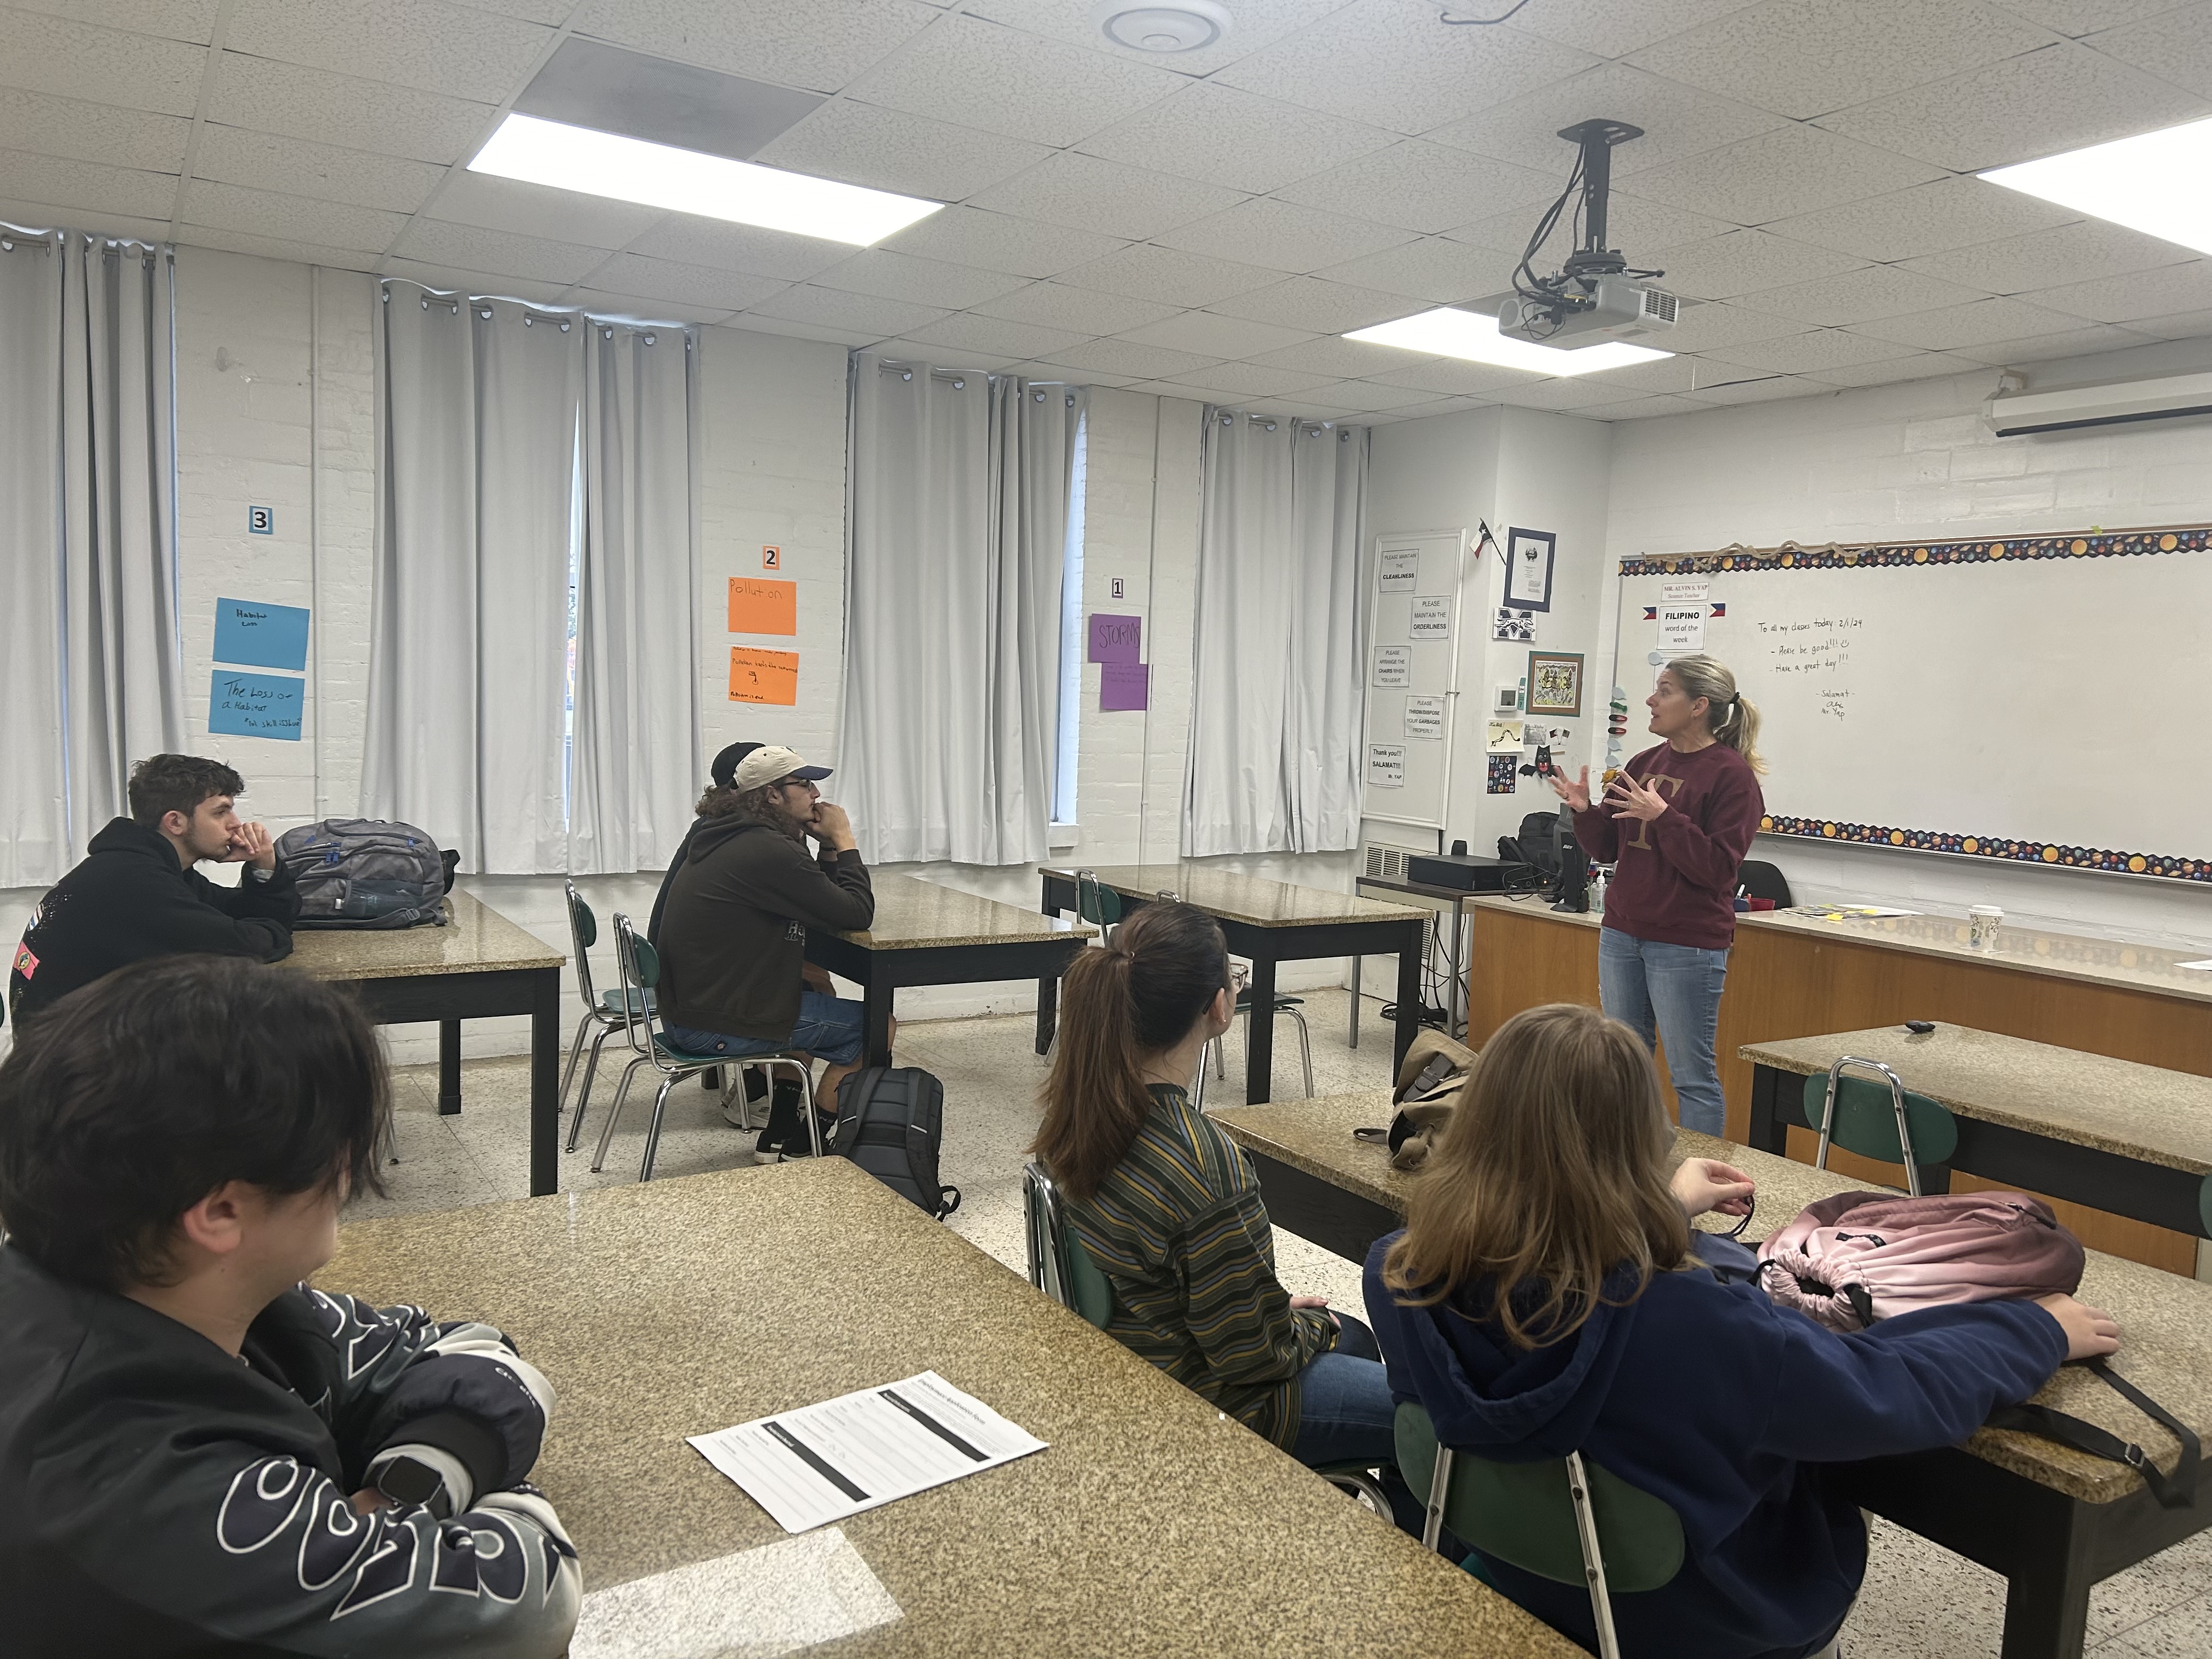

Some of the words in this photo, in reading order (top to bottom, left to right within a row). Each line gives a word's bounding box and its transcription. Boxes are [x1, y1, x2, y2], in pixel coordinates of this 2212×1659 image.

[254, 511, 267, 528] 3
[766, 550, 775, 565] 2
[730, 579, 782, 599] Pollution
[1114, 582, 1121, 594] 1
[1665, 612, 1700, 620] FILIPINO
[1758, 622, 1767, 632] To
[1780, 626, 1788, 635] my
[1791, 622, 1810, 631] classes
[1839, 617, 1862, 629] 2/1/24
[1099, 623, 1139, 649] STORMS
[1779, 645, 1795, 656] Please
[1799, 644, 1808, 653] be
[1776, 663, 1791, 673] Have
[1804, 659, 1821, 673] great
[224, 678, 245, 698] The
[1821, 689, 1850, 698] Salamat
[1832, 707, 1845, 721] Yap
